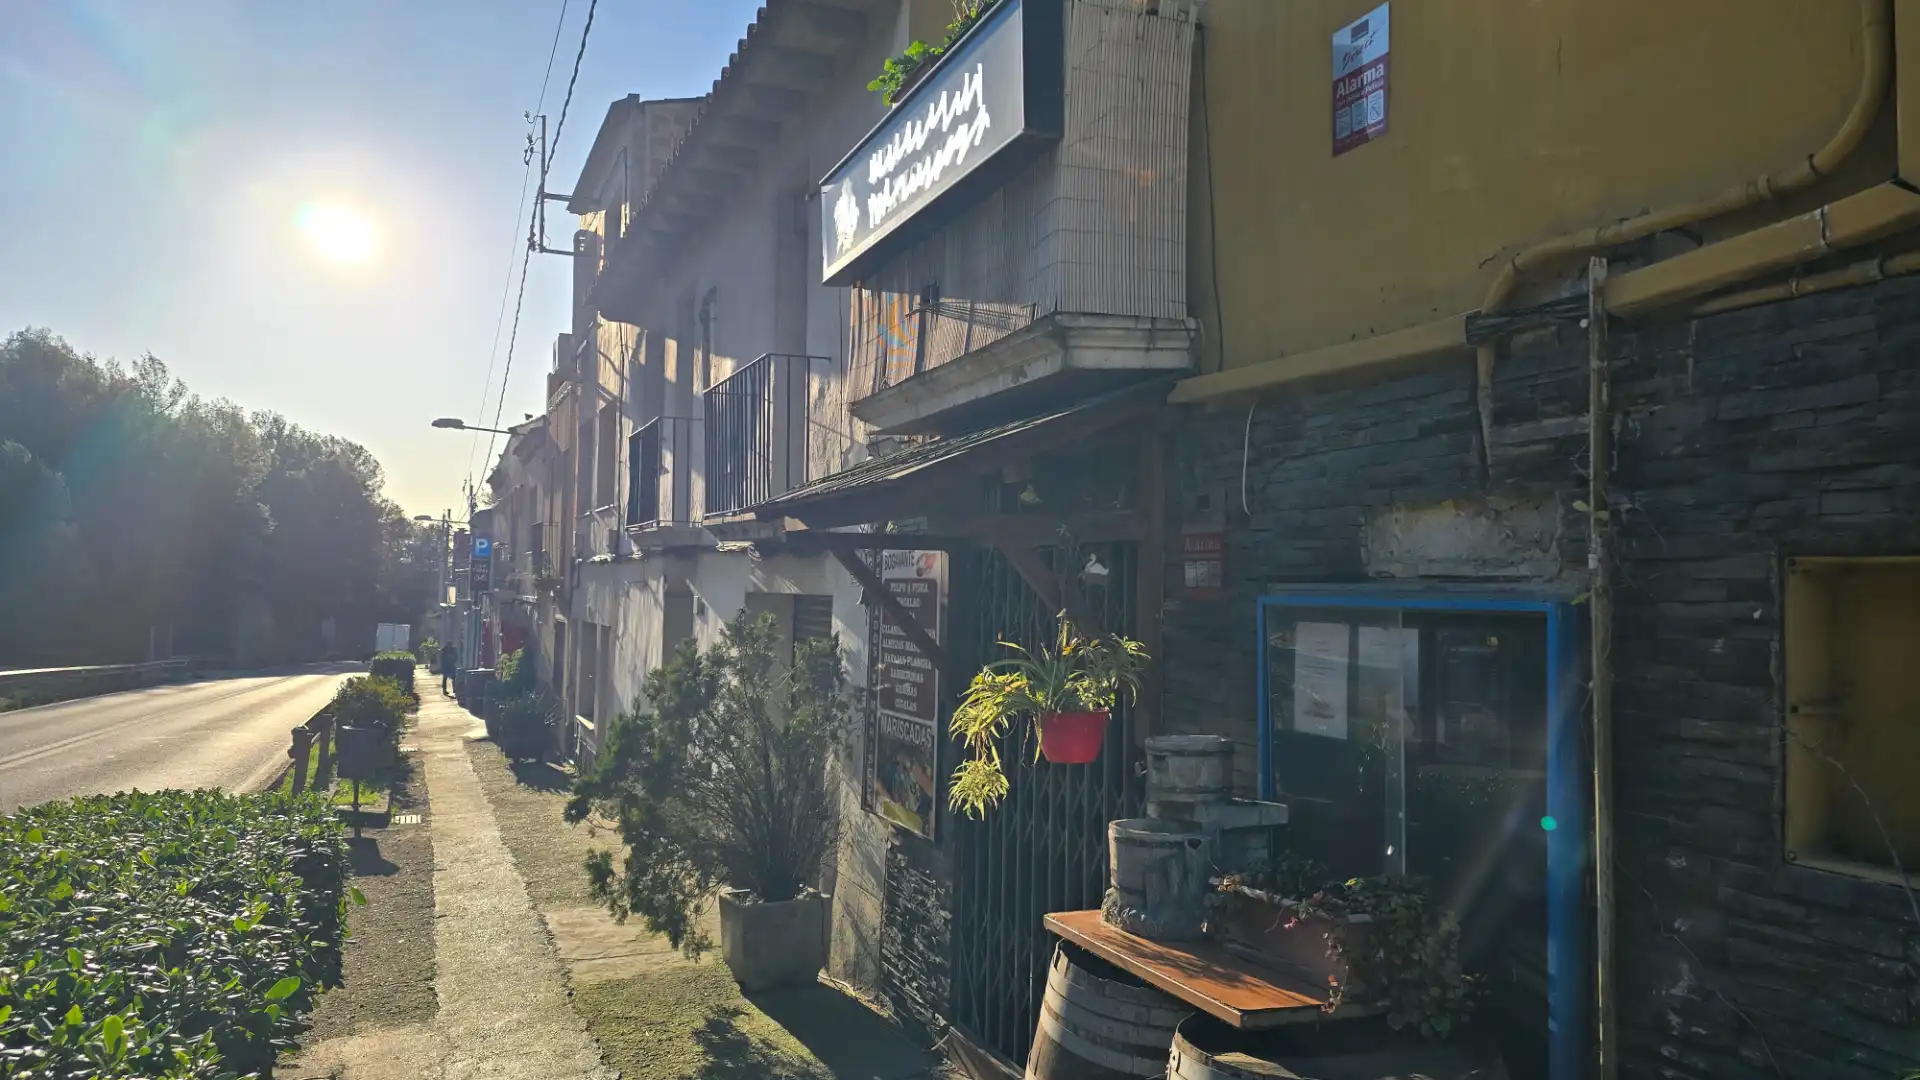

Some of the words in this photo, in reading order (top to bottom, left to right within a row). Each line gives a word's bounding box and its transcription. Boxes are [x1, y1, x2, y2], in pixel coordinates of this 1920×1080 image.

[1336, 63, 1384, 99] Alarma
[475, 538, 489, 556] P
[872, 554, 881, 657] PEADOS
[880, 715, 932, 748] MARISCADAS
